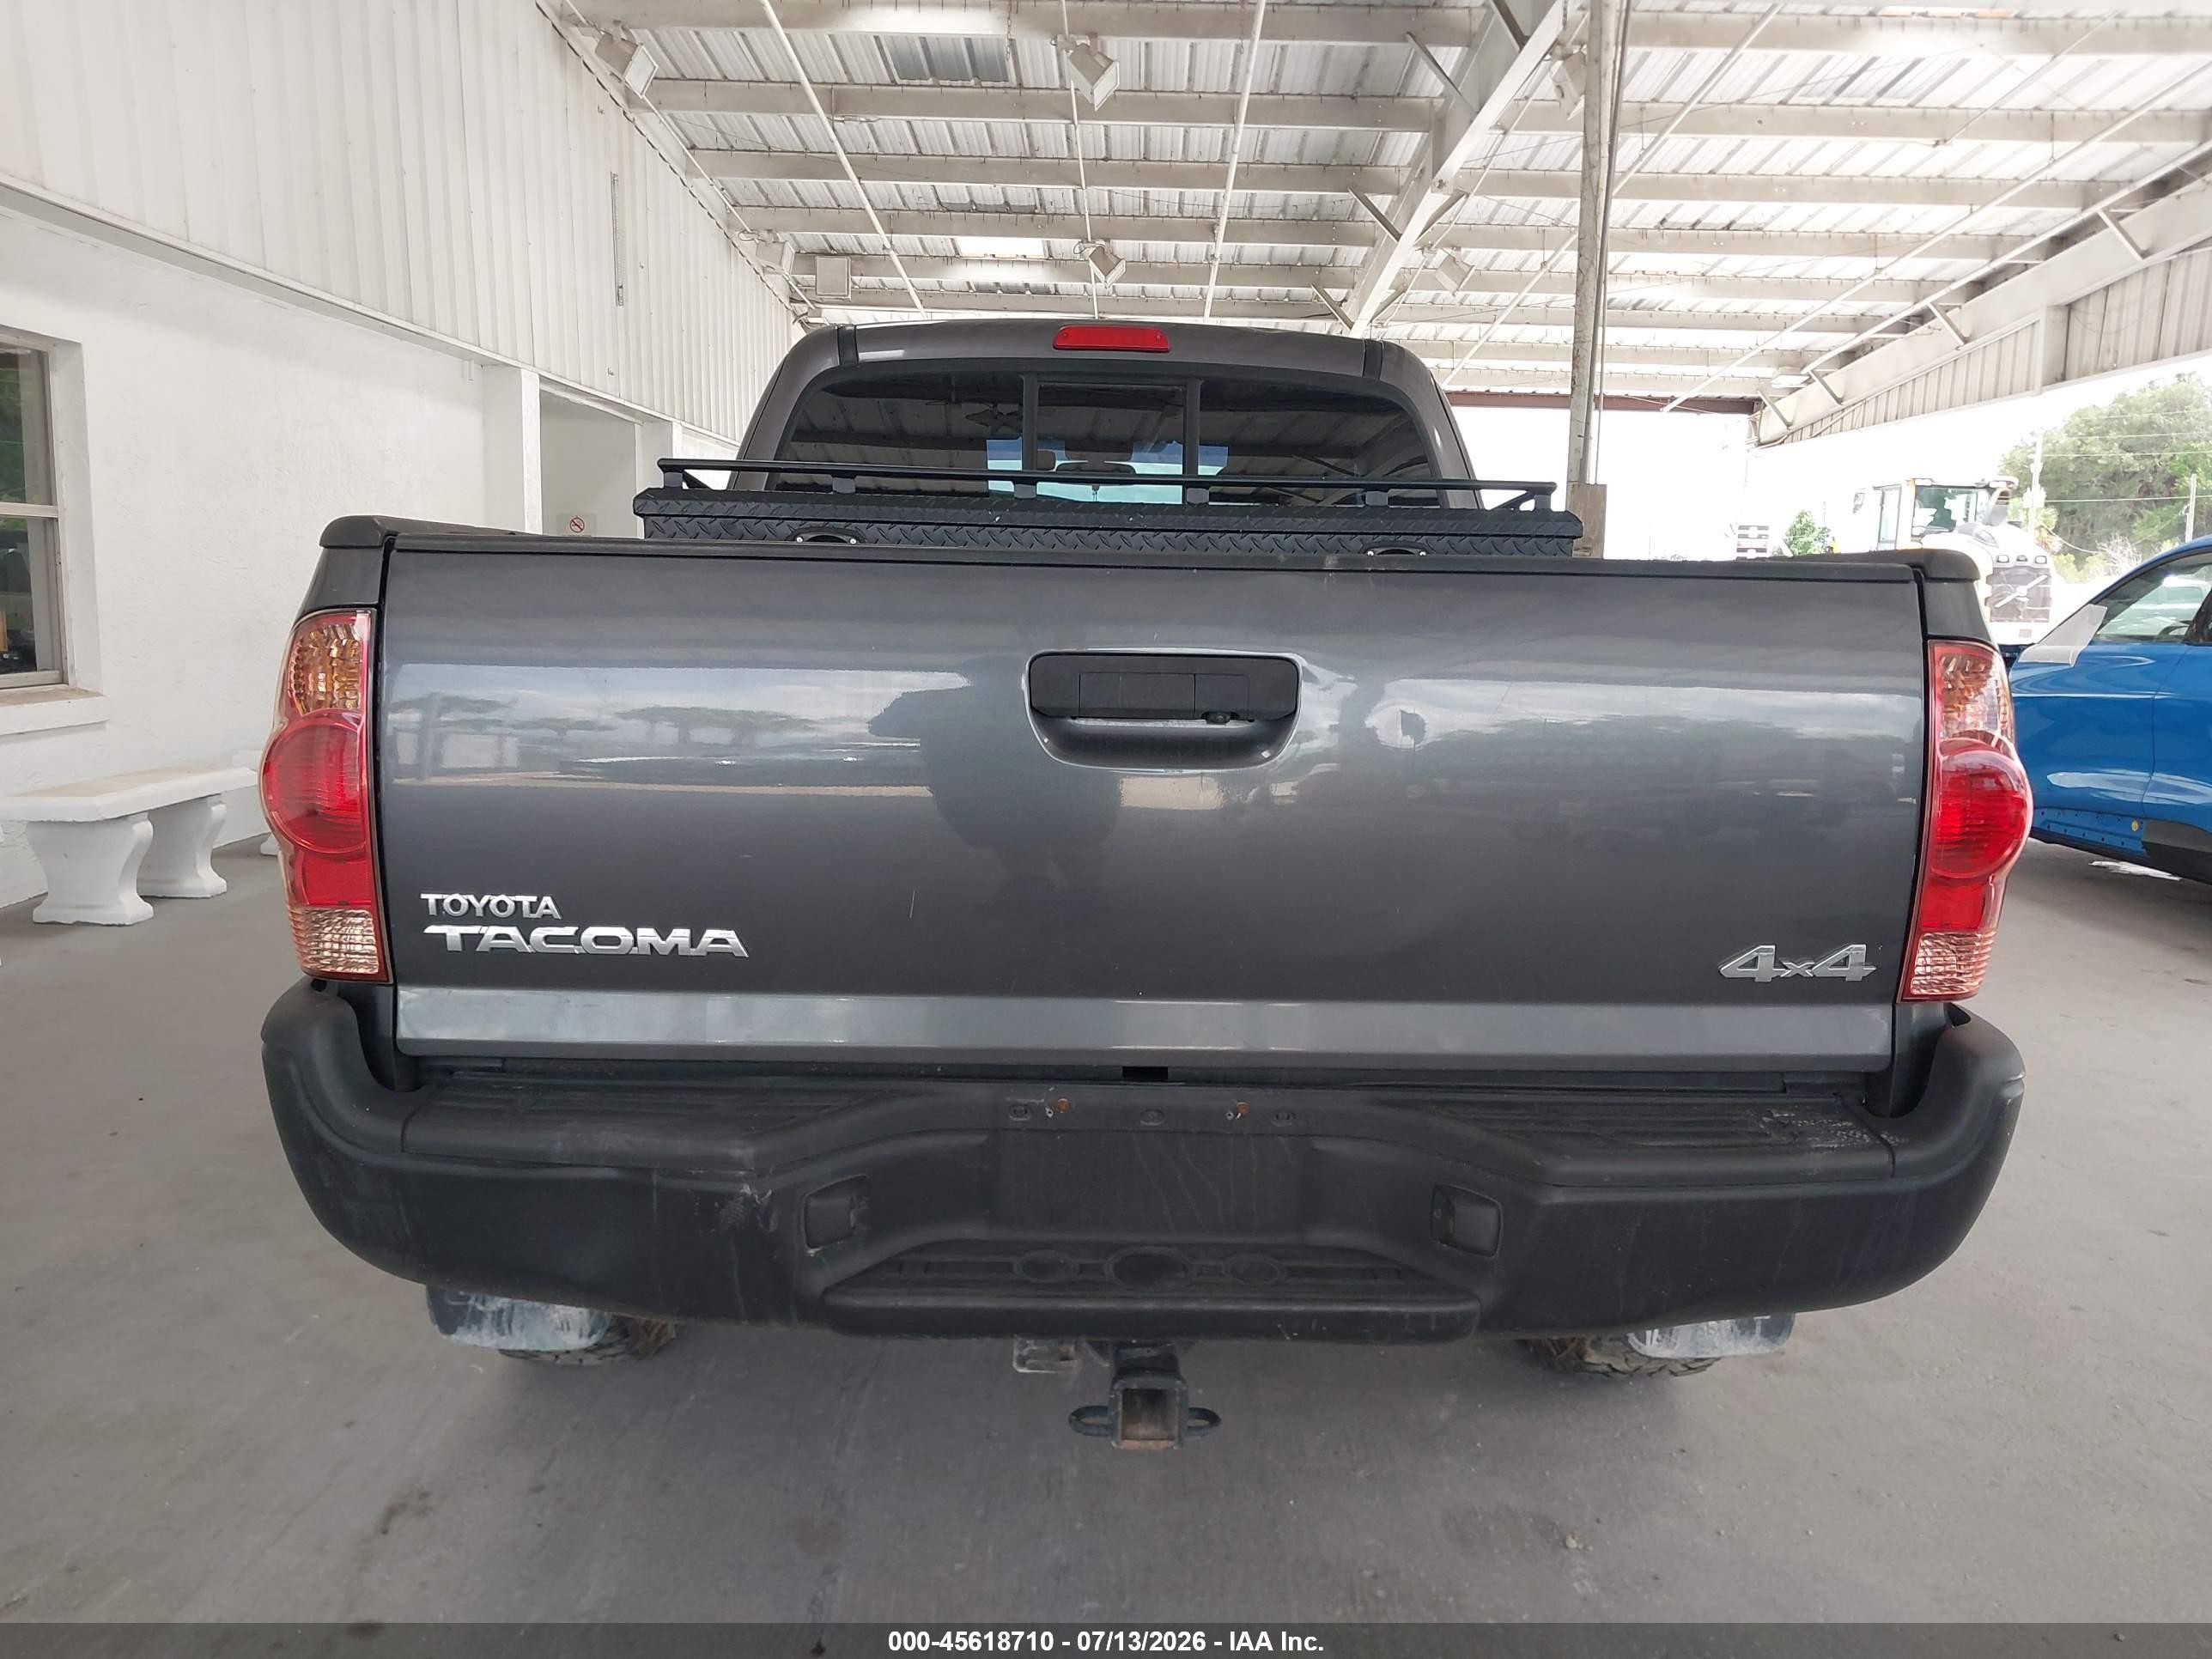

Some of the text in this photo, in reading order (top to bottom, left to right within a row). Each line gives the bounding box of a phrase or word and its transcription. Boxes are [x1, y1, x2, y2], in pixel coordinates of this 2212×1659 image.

[421, 892, 562, 919] TOYOTA
[422, 925, 750, 957] TACOMA
[1719, 944, 1877, 981] 4x4
